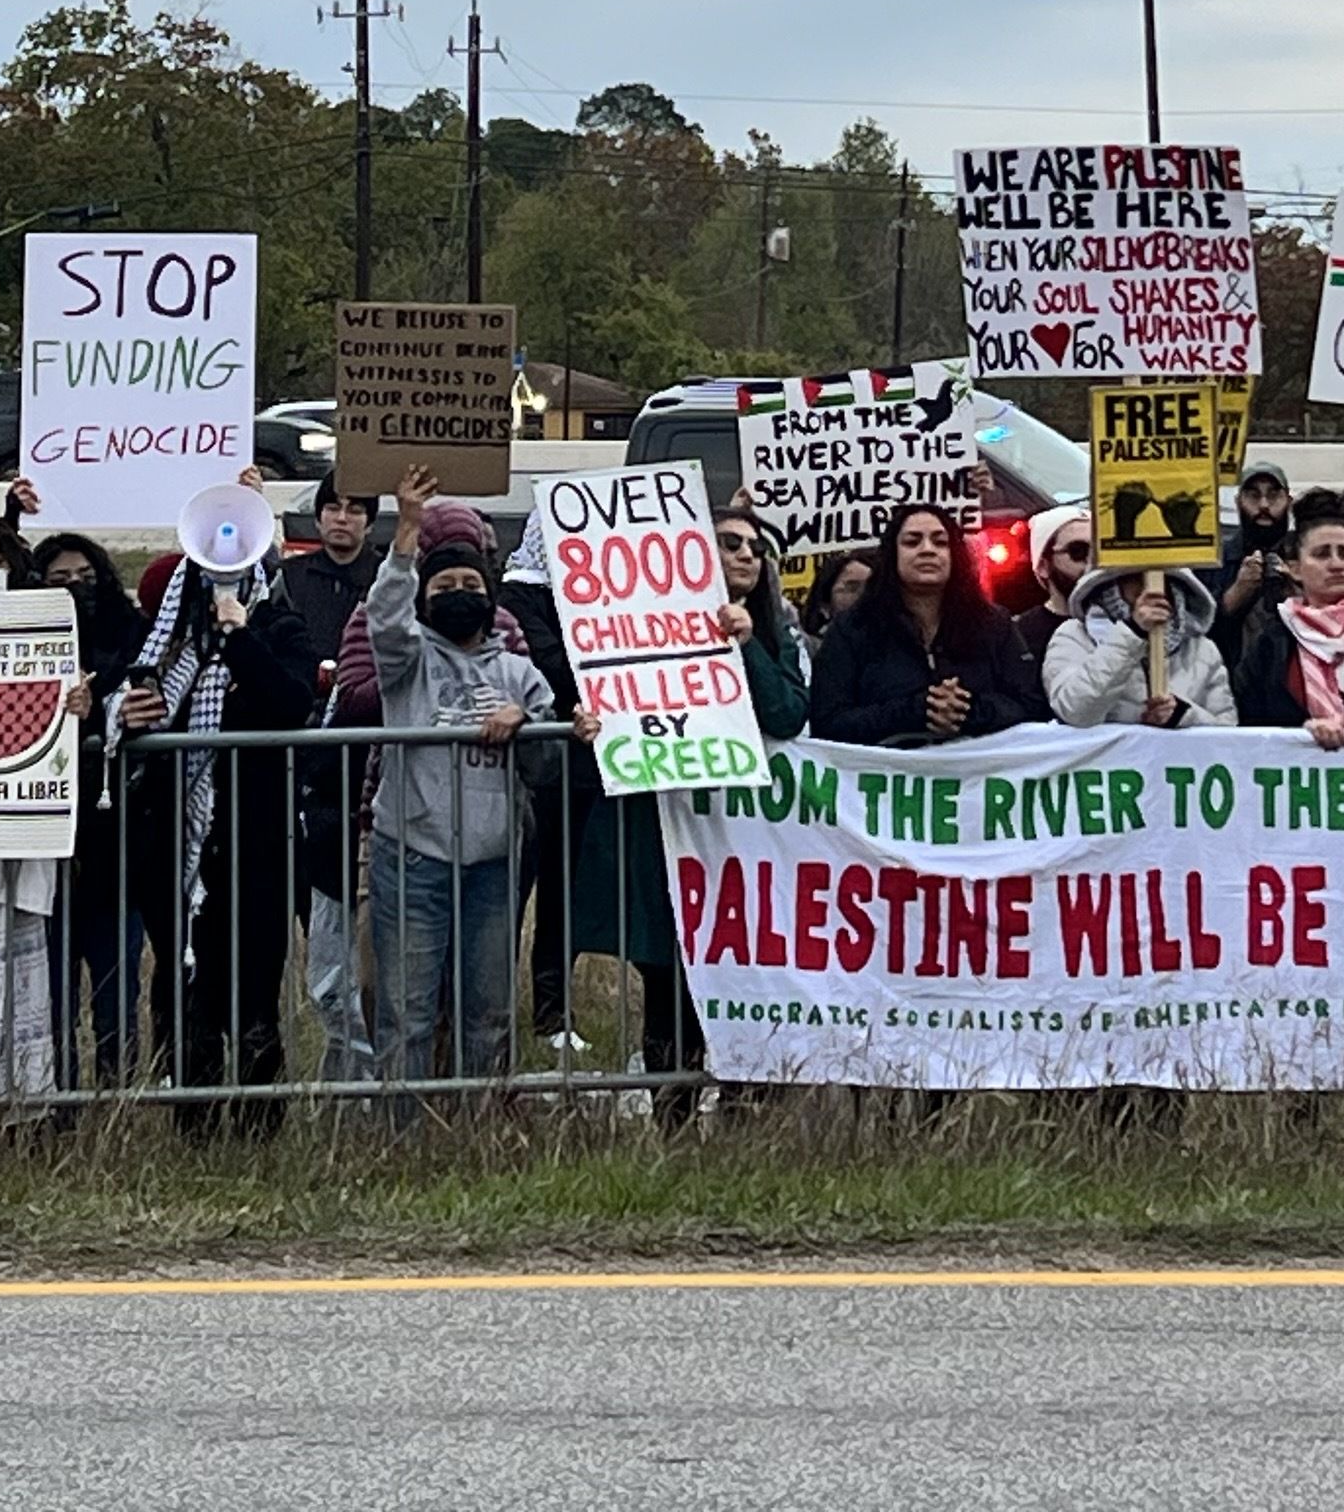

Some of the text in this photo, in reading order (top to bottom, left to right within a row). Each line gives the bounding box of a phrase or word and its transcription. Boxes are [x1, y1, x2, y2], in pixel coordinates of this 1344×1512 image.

[962, 145, 1244, 192] WE ARE PALESTINE
[1049, 192, 1095, 230] BE
[1117, 192, 1232, 230] HERE
[1022, 236, 1077, 272] YOUR
[58, 249, 237, 321] STOP
[962, 273, 1252, 315] YOUR SOUL SHAKES &
[343, 308, 505, 330] WE REFUSE TO
[1122, 312, 1258, 346] HUMANITY
[32, 336, 245, 396] FUNDING
[340, 340, 445, 358] CONTINUE
[966, 320, 1124, 377] YOUR FOR
[1137, 344, 1248, 373] WAKES
[343, 389, 402, 407] YOUR
[472, 371, 497, 386] TO
[340, 412, 513, 440] IN GENOCIDES
[772, 403, 913, 440] FROM THE
[1104, 392, 1202, 437] FREE
[31, 423, 240, 464] GENOCIDE
[754, 431, 966, 471] RIVER TO THE
[1099, 436, 1210, 463] PALESTINE
[549, 471, 698, 533] OVER
[753, 465, 979, 509] SEA PALESTINE
[787, 508, 868, 547] WILL
[557, 529, 714, 607] 8,000
[570, 610, 729, 654] CHILDREN
[583, 660, 743, 716] KILLED
[639, 712, 689, 738] BY
[602, 734, 758, 787] GREED
[16, 779, 70, 800] LIBRE
[857, 772, 960, 845] THE
[983, 769, 1147, 841] RIVER
[1165, 763, 1235, 830] TO
[677, 855, 1034, 979] PALESTINE
[1058, 868, 1222, 978] WILL
[1247, 864, 1329, 968] BE
[700, 998, 870, 1031] EMOCRATIC
[883, 1006, 1065, 1033] SOCIALISTS
[1134, 999, 1264, 1029] AMERICA
[1276, 998, 1331, 1020] FOR
